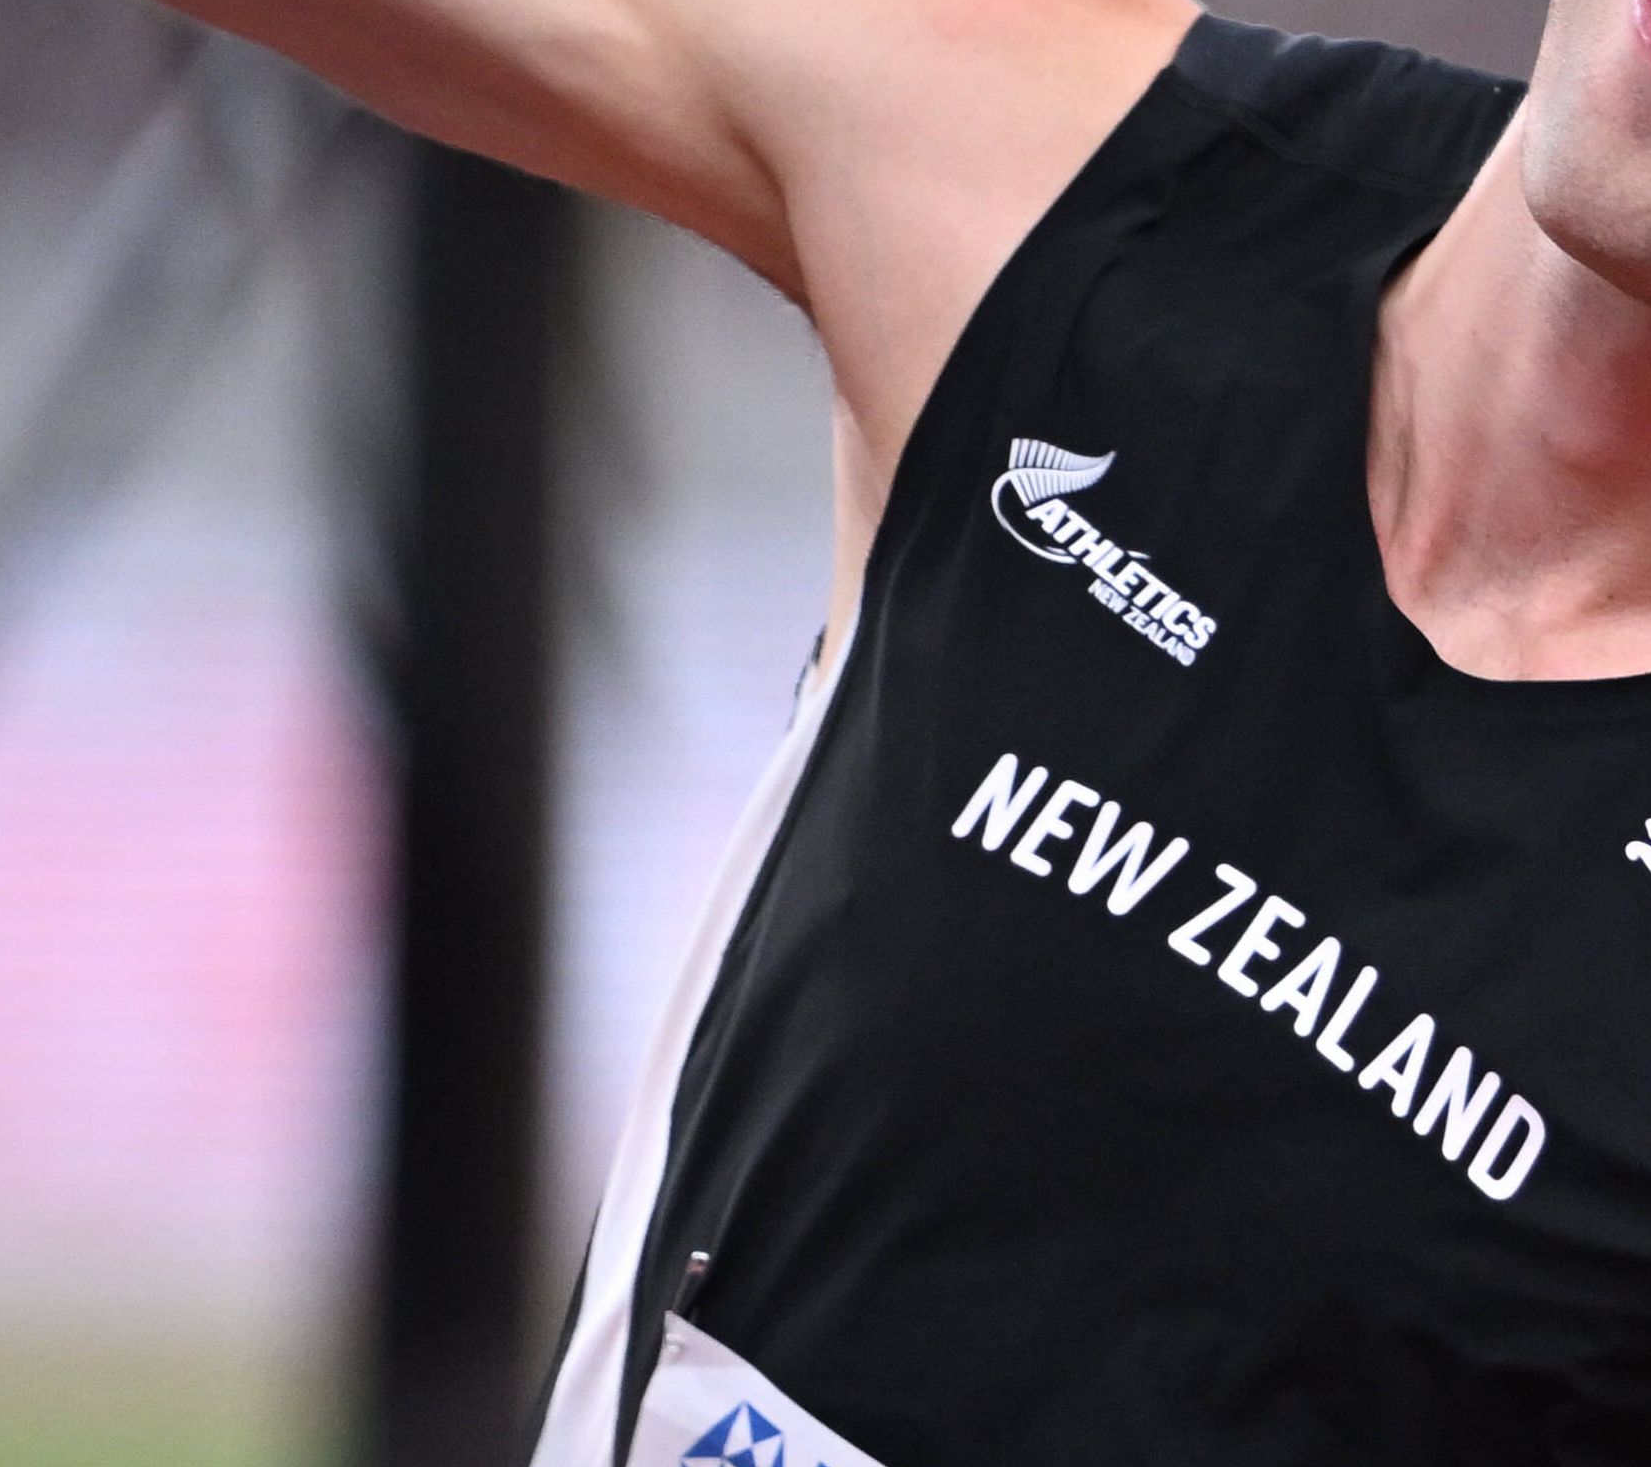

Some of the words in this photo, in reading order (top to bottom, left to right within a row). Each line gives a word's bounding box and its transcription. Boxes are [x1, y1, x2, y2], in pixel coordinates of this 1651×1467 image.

[1025, 498, 1217, 651] ATHLETICS
[1087, 578, 1129, 614] NEW
[1122, 605, 1196, 667] ZEALAND
[951, 752, 1190, 916] NEW
[1167, 863, 1546, 1201] ZEALAND
